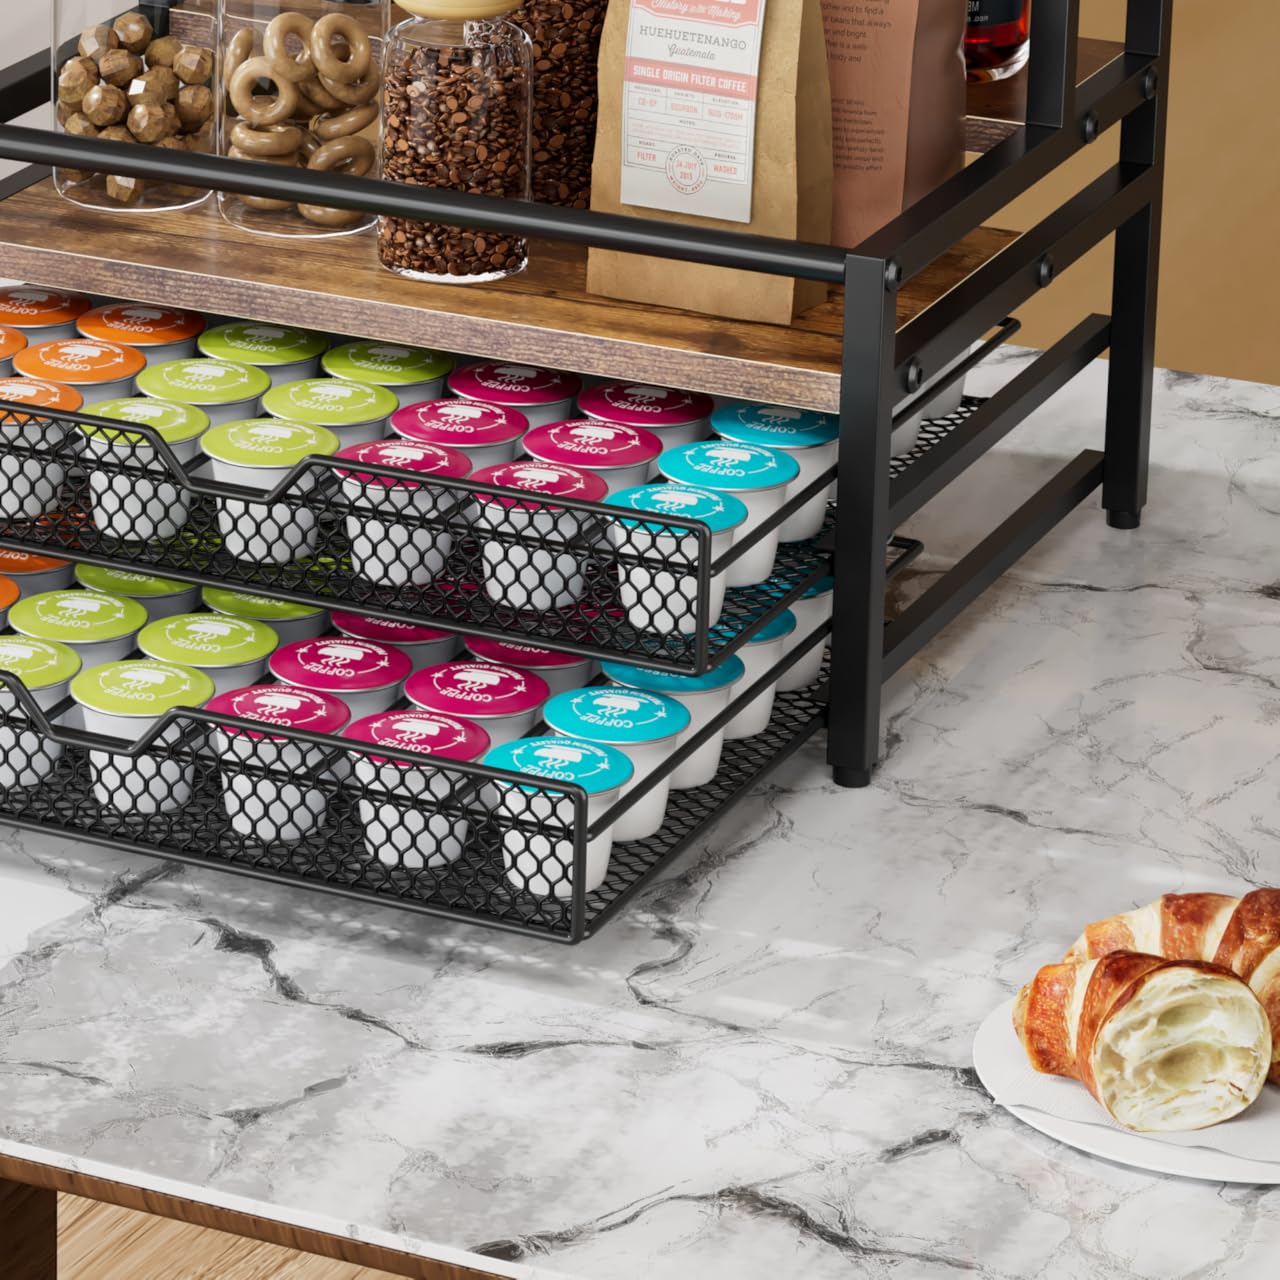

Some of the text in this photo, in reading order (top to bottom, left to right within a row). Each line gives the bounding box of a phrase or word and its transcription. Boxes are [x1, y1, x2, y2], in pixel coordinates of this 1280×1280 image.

[639, 25, 747, 51] HUEHUETENANGO
[667, 43, 716, 60] Guatemala
[633, 65, 748, 93] SINGLE ORIGIN FILTER COFFEE
[43, 358, 91, 372] COFFEE
[171, 379, 217, 392] COFFEE
[480, 379, 530, 393] COFFEE
[296, 398, 345, 412] COFFEE
[612, 398, 662, 414] COFFEE
[424, 420, 475, 433] COFFEE
[746, 420, 796, 434] COFFEE
[234, 439, 283, 454] COFFEE
[558, 440, 608, 455] COFFEE
[693, 462, 745, 476] COFFEE
[48, 614, 91, 628] COFFEE
[171, 639, 221, 653] COFFEE
[304, 662, 355, 677] COFFEE
[104, 686, 156, 701] COFFEE
[440, 686, 492, 702] COFFEE
[580, 713, 634, 728] COFFEE
[377, 737, 432, 754] COFFEE
[522, 764, 575, 781] COFFEE
